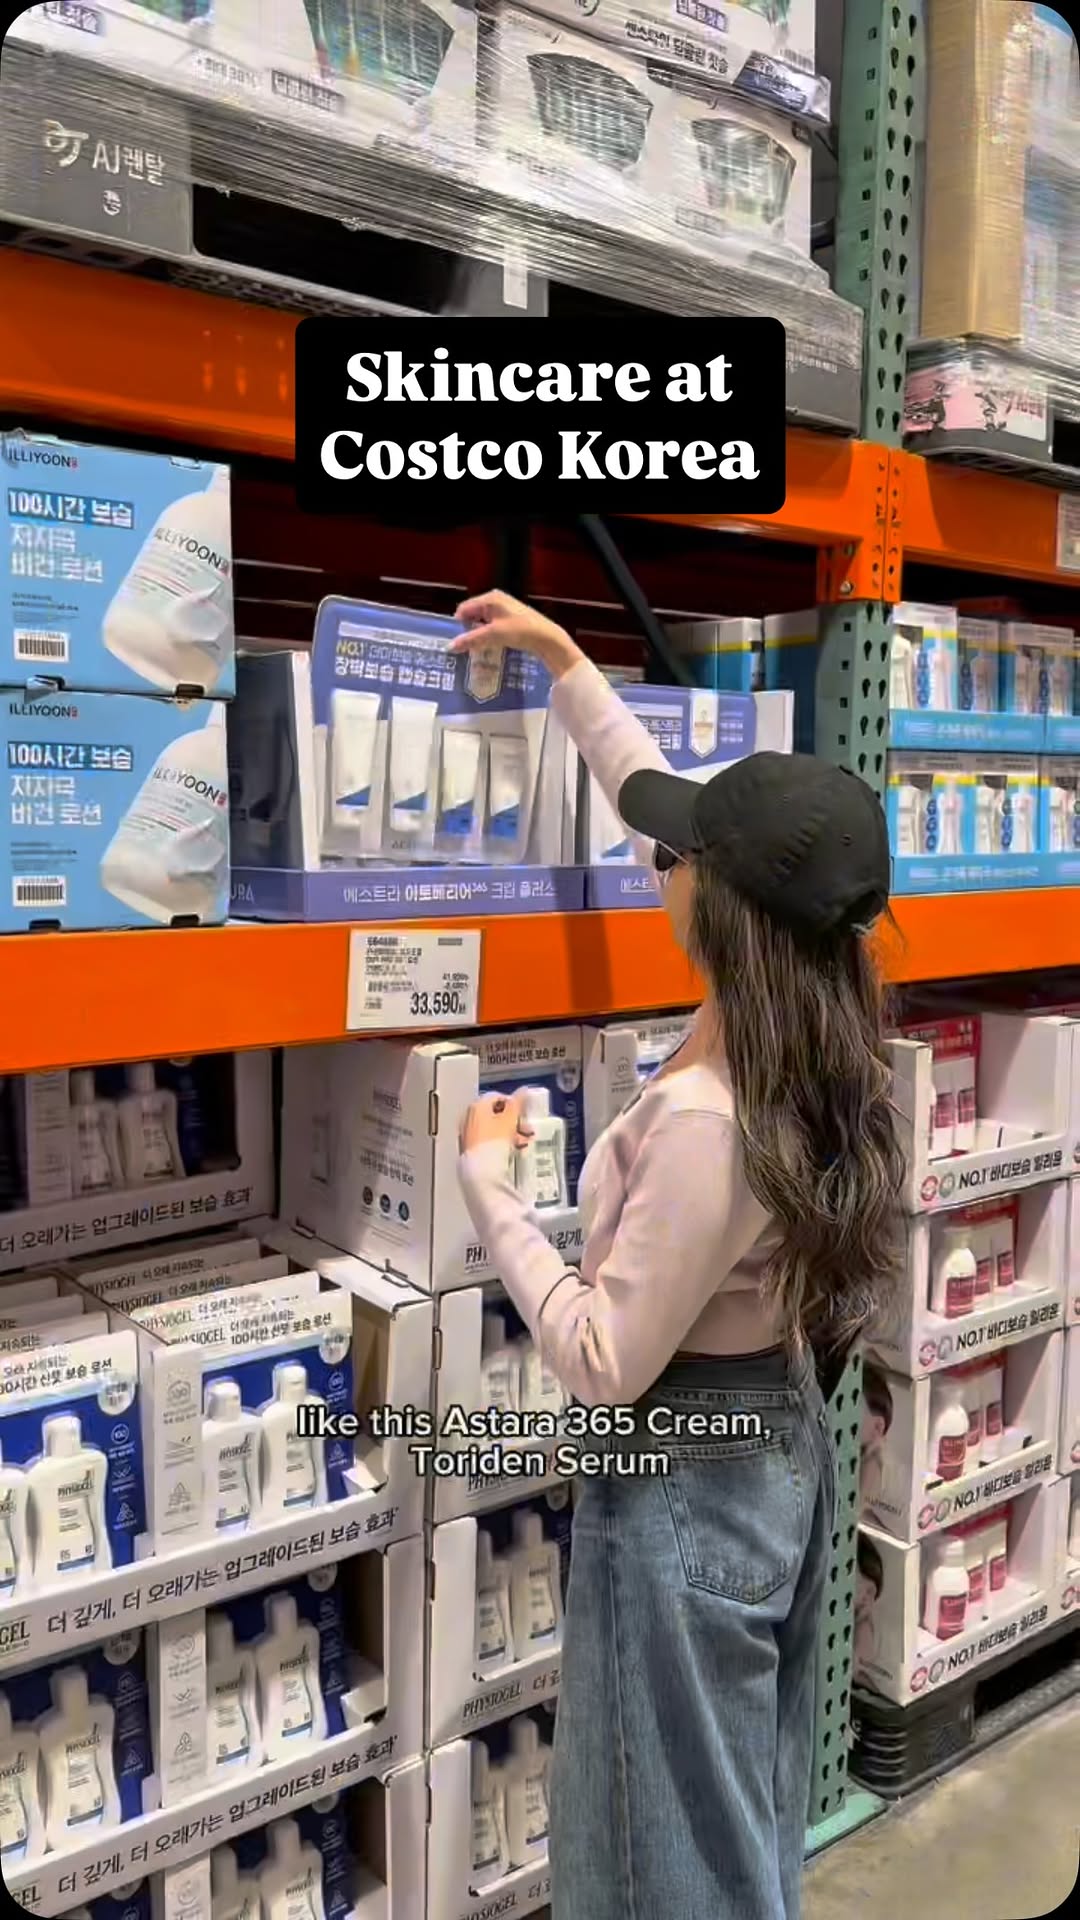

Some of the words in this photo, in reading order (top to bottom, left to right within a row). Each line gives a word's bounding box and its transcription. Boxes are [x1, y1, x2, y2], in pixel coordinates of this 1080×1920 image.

[92, 140, 166, 187] AJ렌탈
[8, 448, 71, 468] ILLIYOON
[10, 491, 86, 521] 100시간
[92, 500, 132, 528] 보습
[9, 703, 70, 717] ILLIYOON
[9, 743, 84, 769] 100시간
[90, 746, 131, 770] 보습
[60, 800, 102, 825] 로션
[343, 885, 400, 904] 에스트라
[491, 882, 515, 899] 크림
[20, 1222, 87, 1250] 오래가는
[92, 1200, 185, 1236] 업그레이드된
[190, 1194, 217, 1214] 보습
[231, 1325, 268, 1345] 100시간
[292, 1316, 311, 1333] 보습
[66, 1364, 88, 1380] 보습
[47, 1610, 66, 1633] 더
[73, 1598, 116, 1630] 깊게,
[123, 1588, 140, 1610] 더
[147, 1568, 219, 1604] 오래가는
[225, 1530, 325, 1581] 업그레이드된
[328, 1520, 361, 1545] 보습
[58, 1872, 77, 1894] 더
[83, 1853, 125, 1886] 깊게,
[130, 1841, 149, 1863] 더
[155, 1814, 224, 1854] 오래가는
[229, 1765, 327, 1824] 업그레이드된
[329, 1754, 361, 1778] 보습
